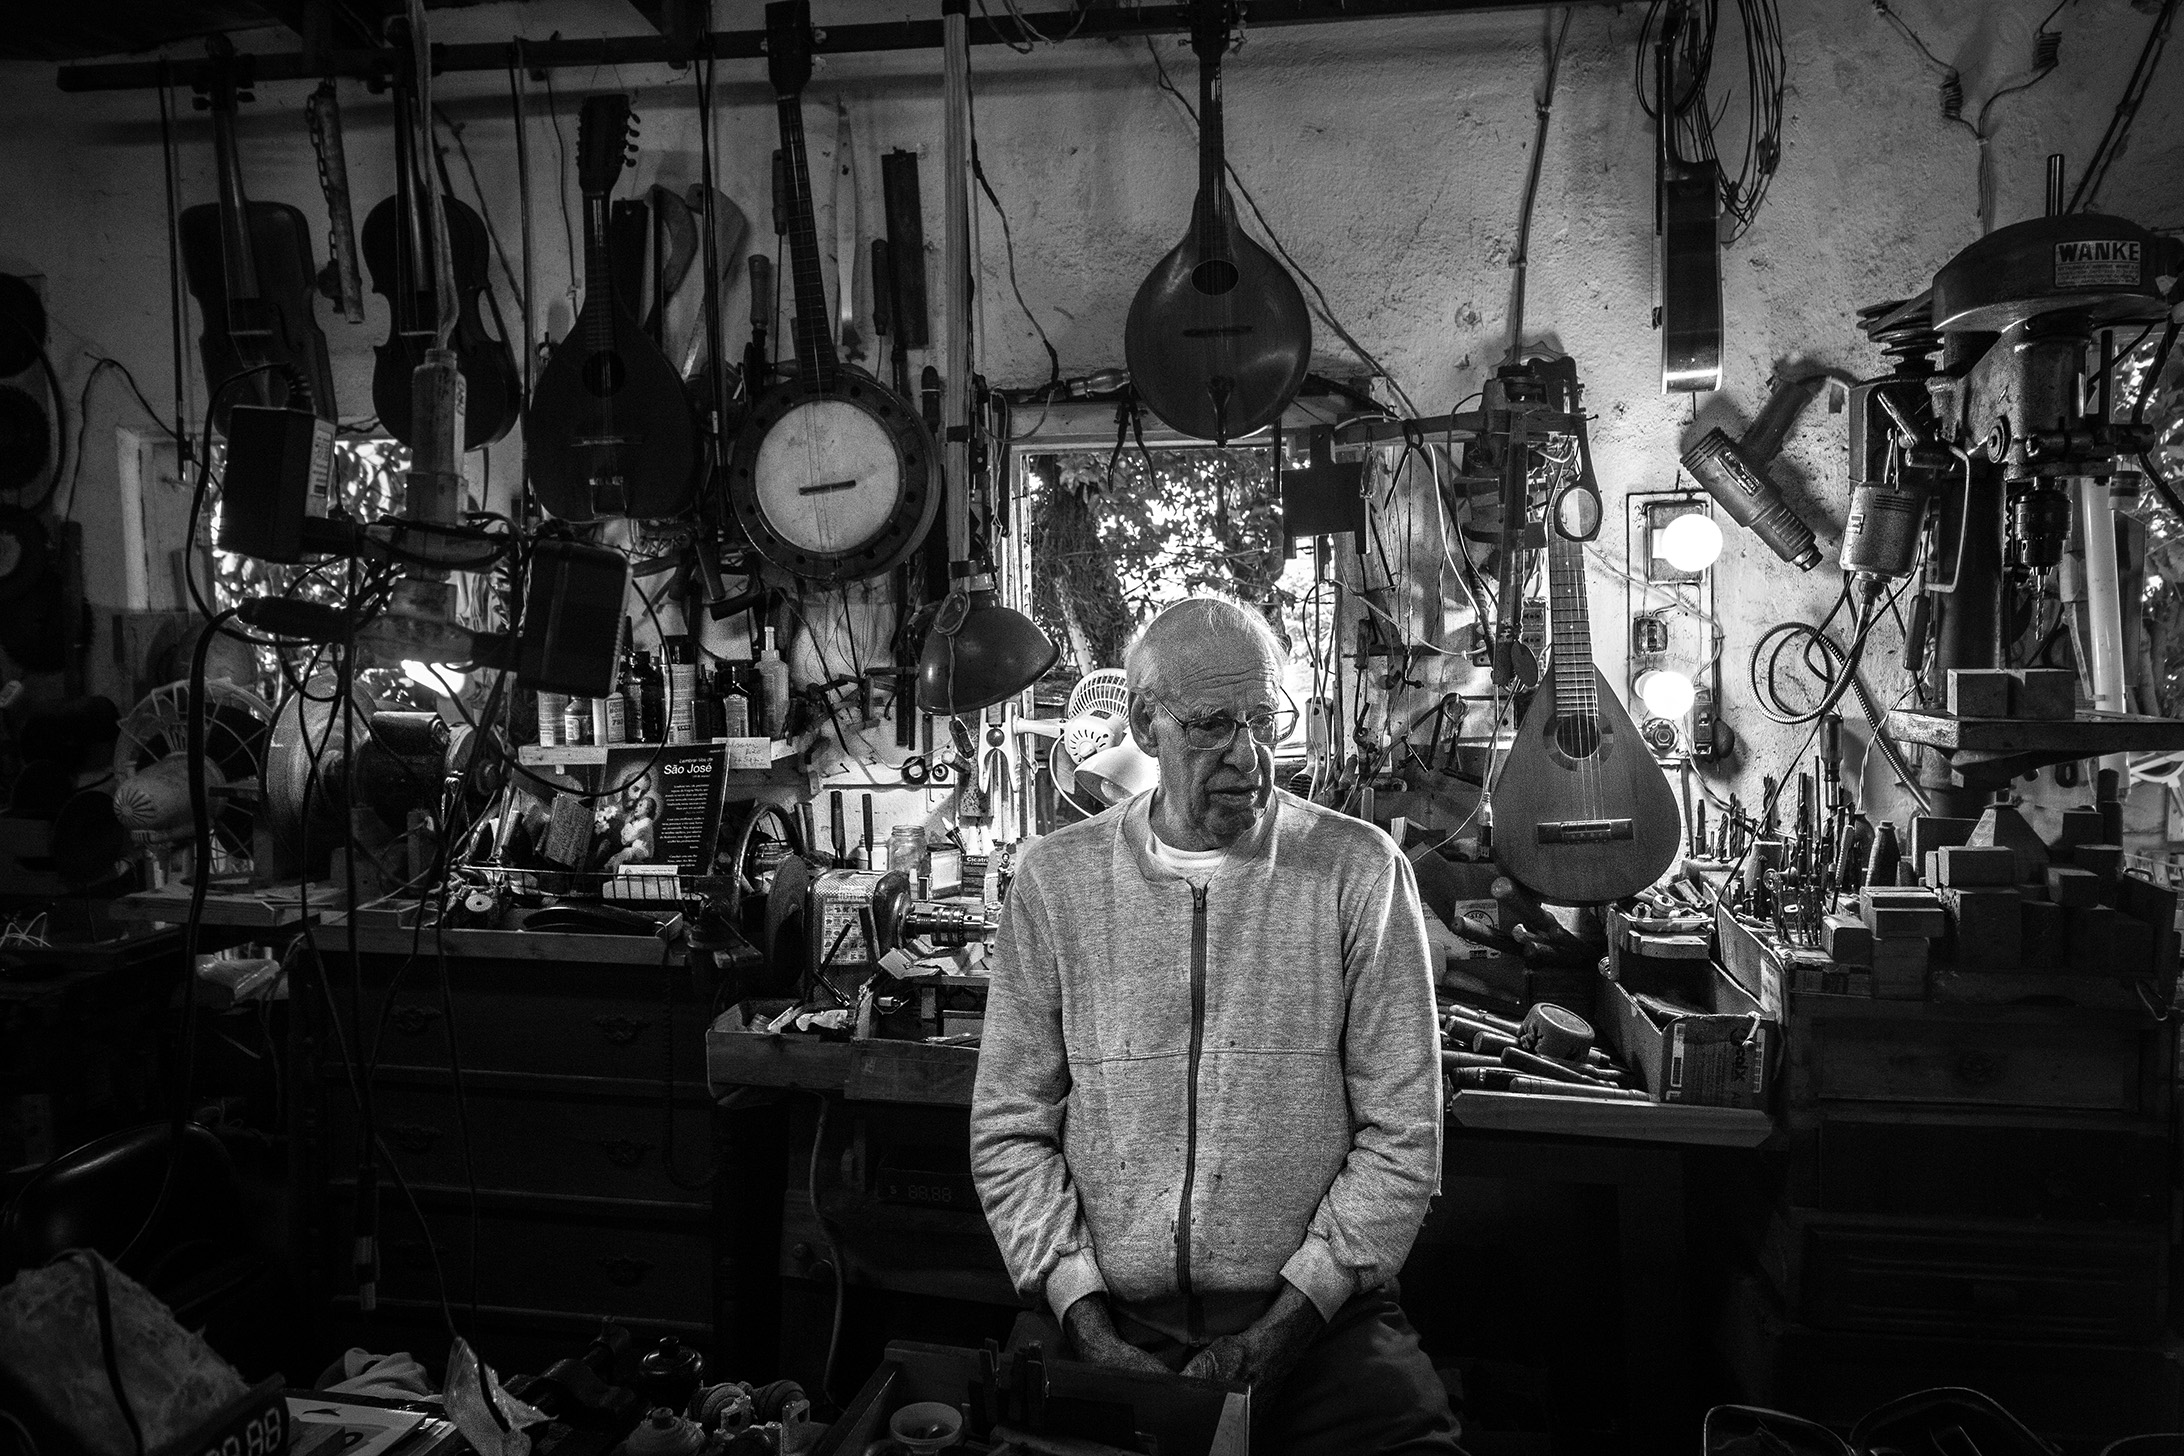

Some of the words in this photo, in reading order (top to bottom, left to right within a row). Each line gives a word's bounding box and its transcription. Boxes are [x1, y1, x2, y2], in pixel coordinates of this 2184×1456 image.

[2059, 242, 2139, 262] WANKE
[664, 764, 685, 775] São
[687, 762, 713, 774] José
